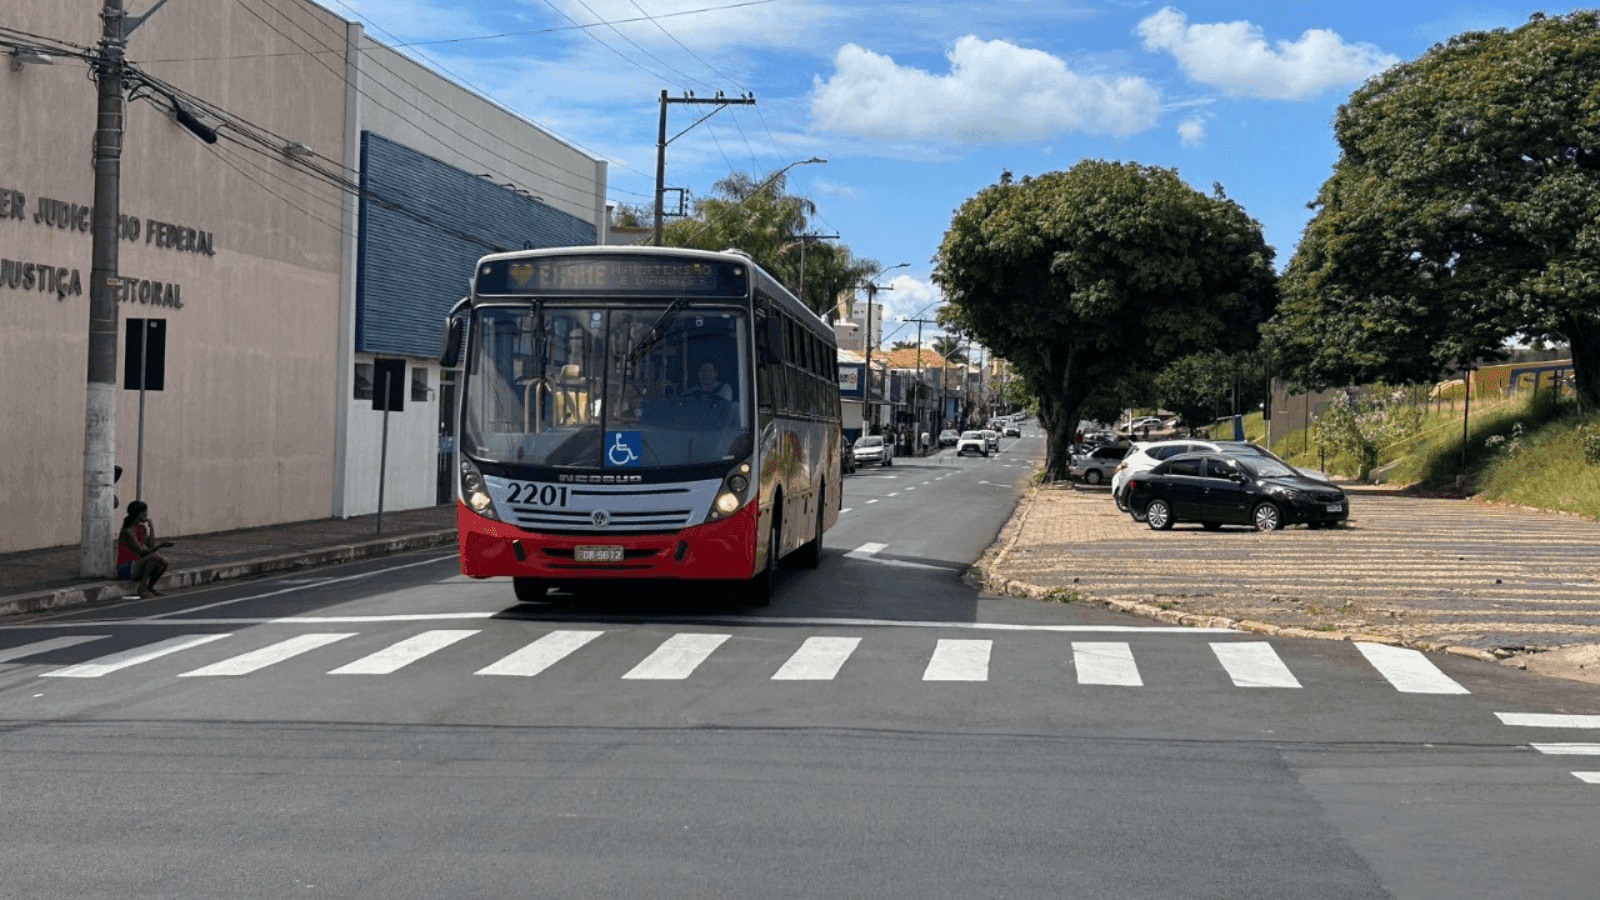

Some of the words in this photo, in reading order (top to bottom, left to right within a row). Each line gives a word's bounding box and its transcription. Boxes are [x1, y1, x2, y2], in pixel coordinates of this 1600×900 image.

[146, 218, 216, 257] FEDERAL
[0, 258, 82, 302] JUSTIÇA
[116, 275, 184, 309] EITORAL
[506, 483, 568, 507] 2201
